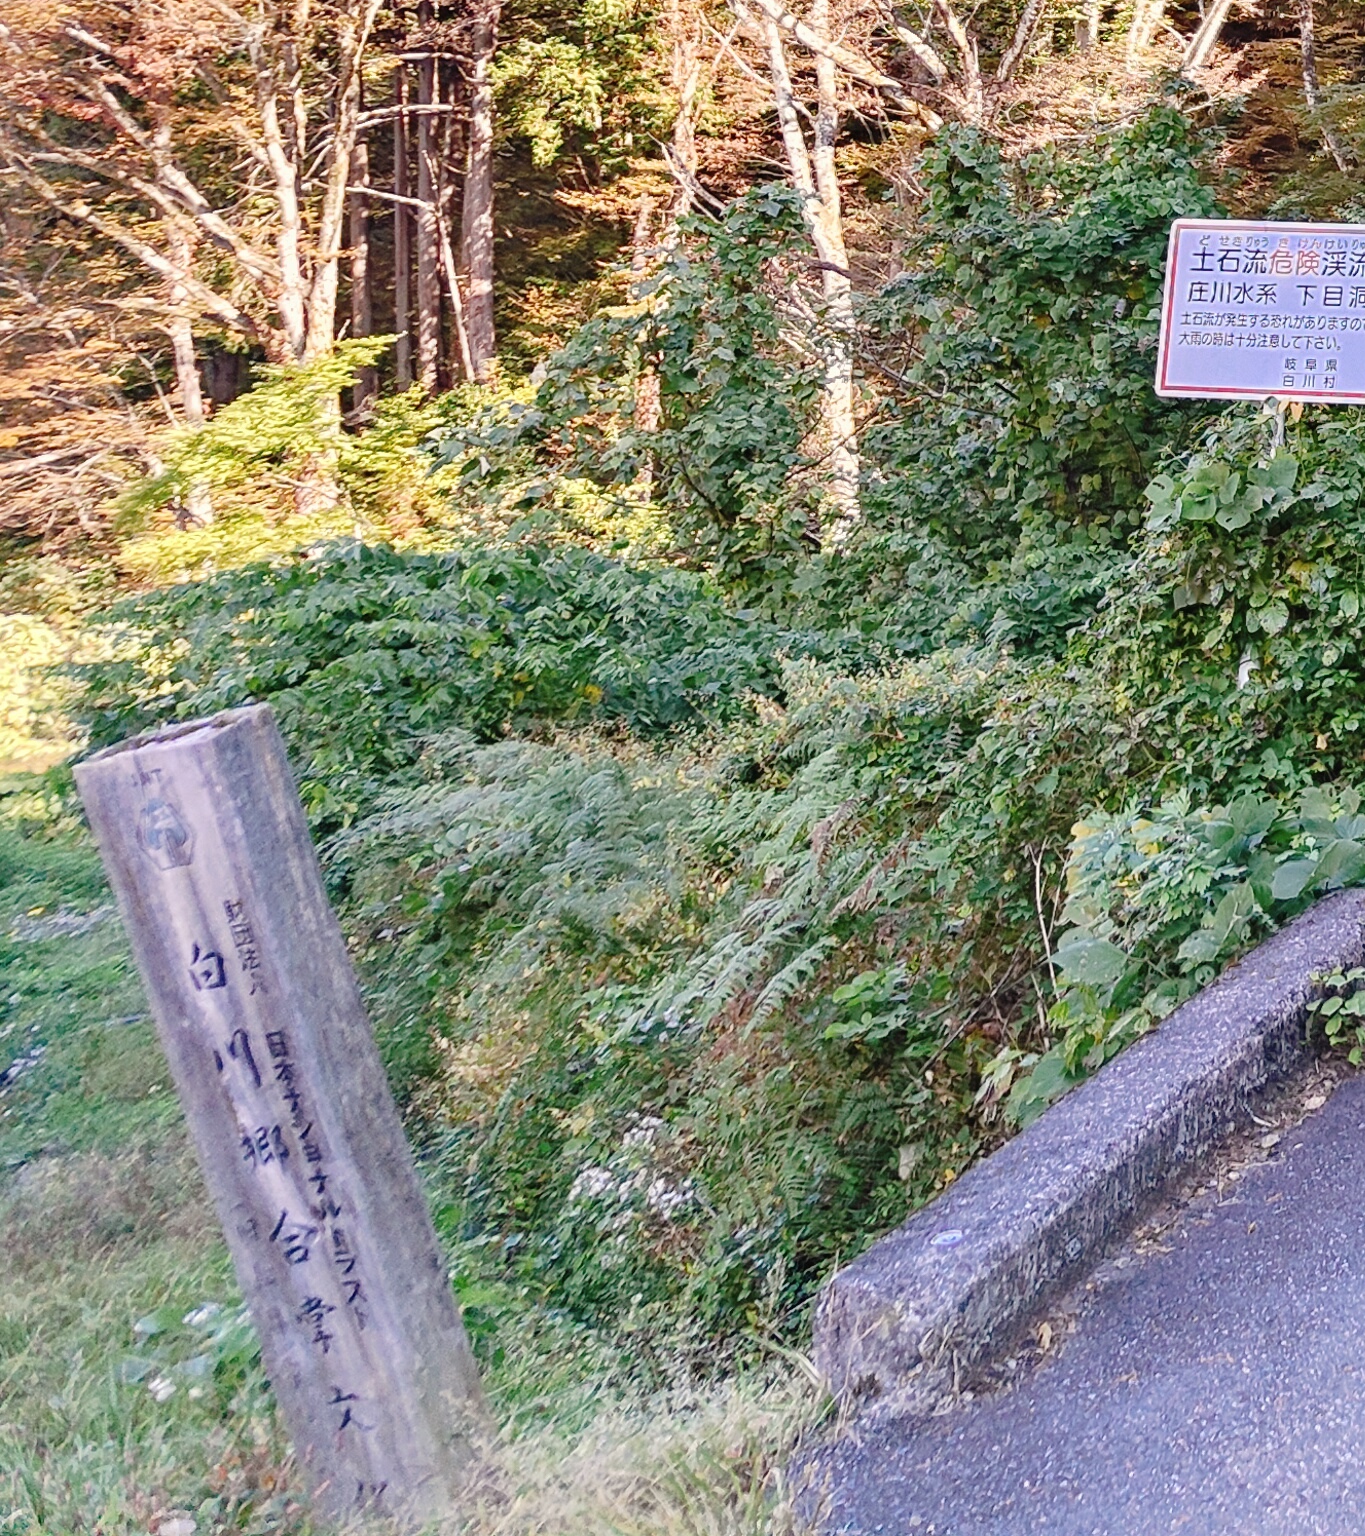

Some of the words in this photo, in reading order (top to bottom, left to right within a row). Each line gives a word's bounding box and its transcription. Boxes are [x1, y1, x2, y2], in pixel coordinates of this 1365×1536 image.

[1187, 281, 1278, 305] 庄川水系
[1177, 330, 1342, 352] 大雨の時は十分注意して下さい。
[1284, 357, 1338, 372] 岐阜県
[1283, 374, 1336, 389] 白川村
